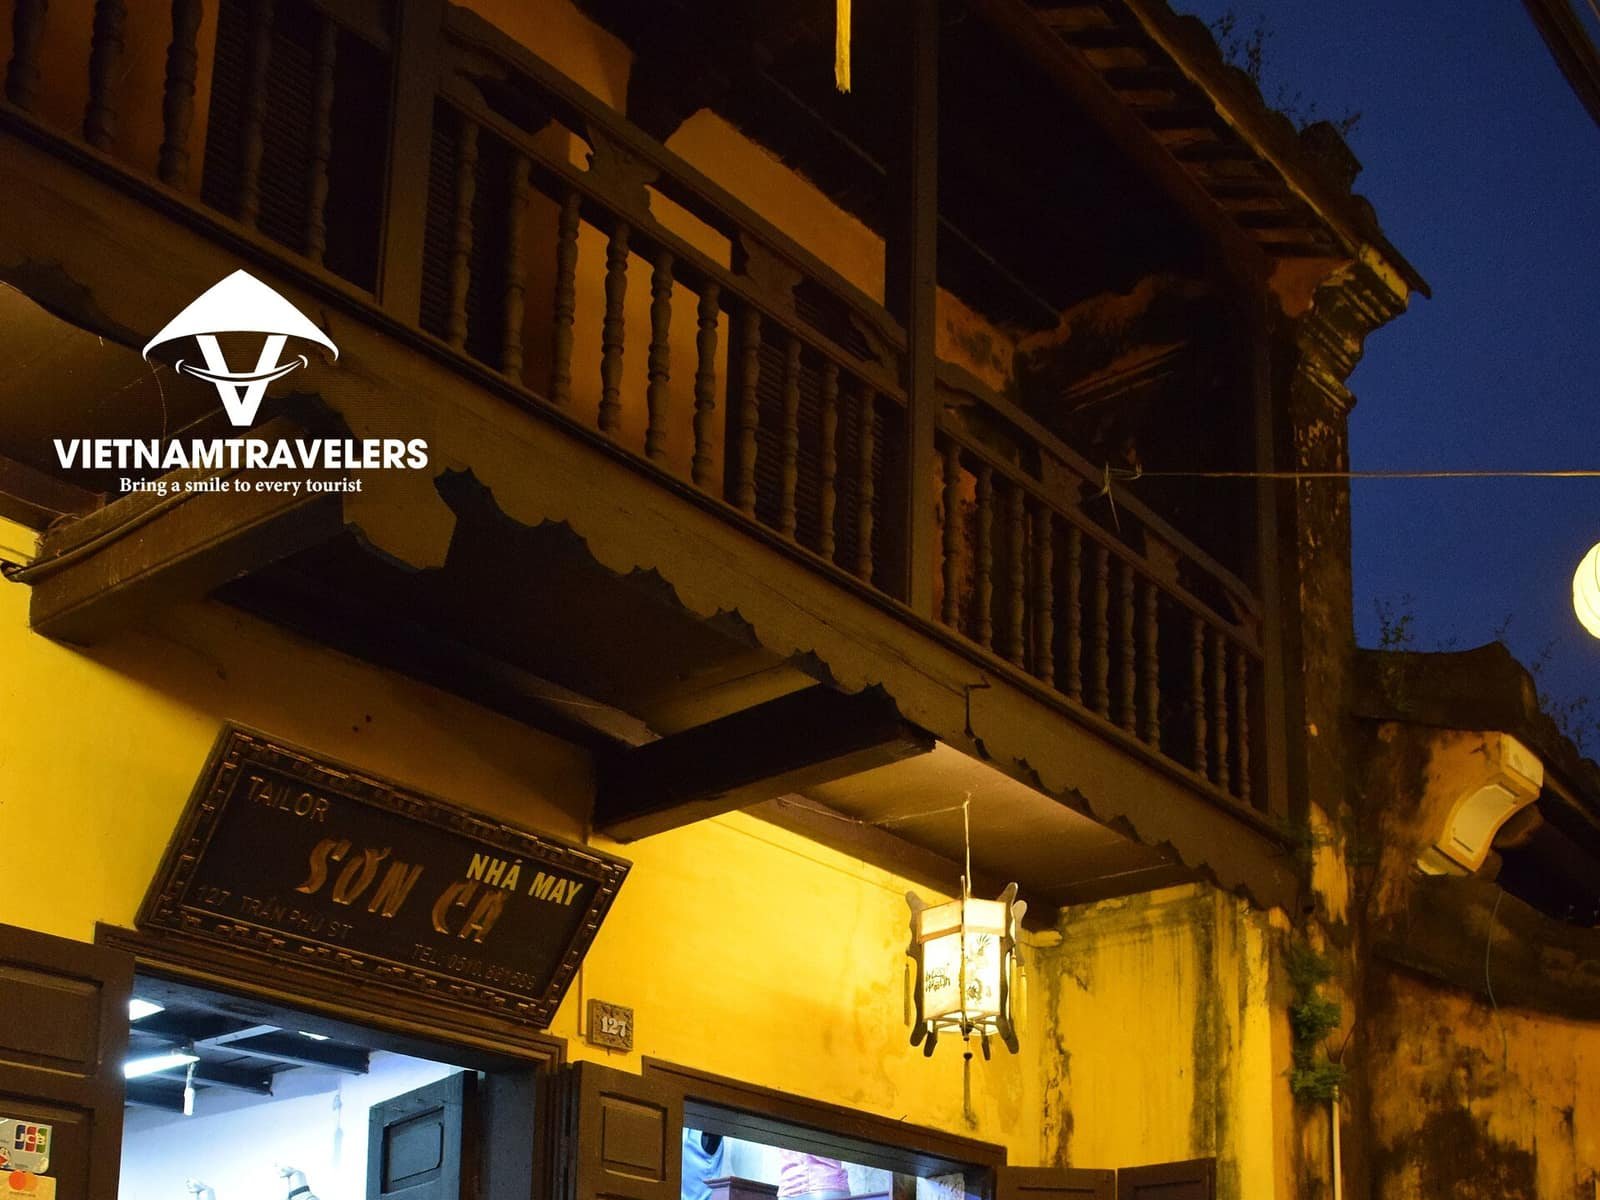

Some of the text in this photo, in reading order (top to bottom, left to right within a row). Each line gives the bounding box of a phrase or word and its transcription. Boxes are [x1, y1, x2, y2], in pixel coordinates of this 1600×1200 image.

[247, 775, 330, 823] TAILOR
[528, 872, 584, 906] MAY
[431, 880, 506, 944] CA
[601, 1015, 627, 1037] 127
